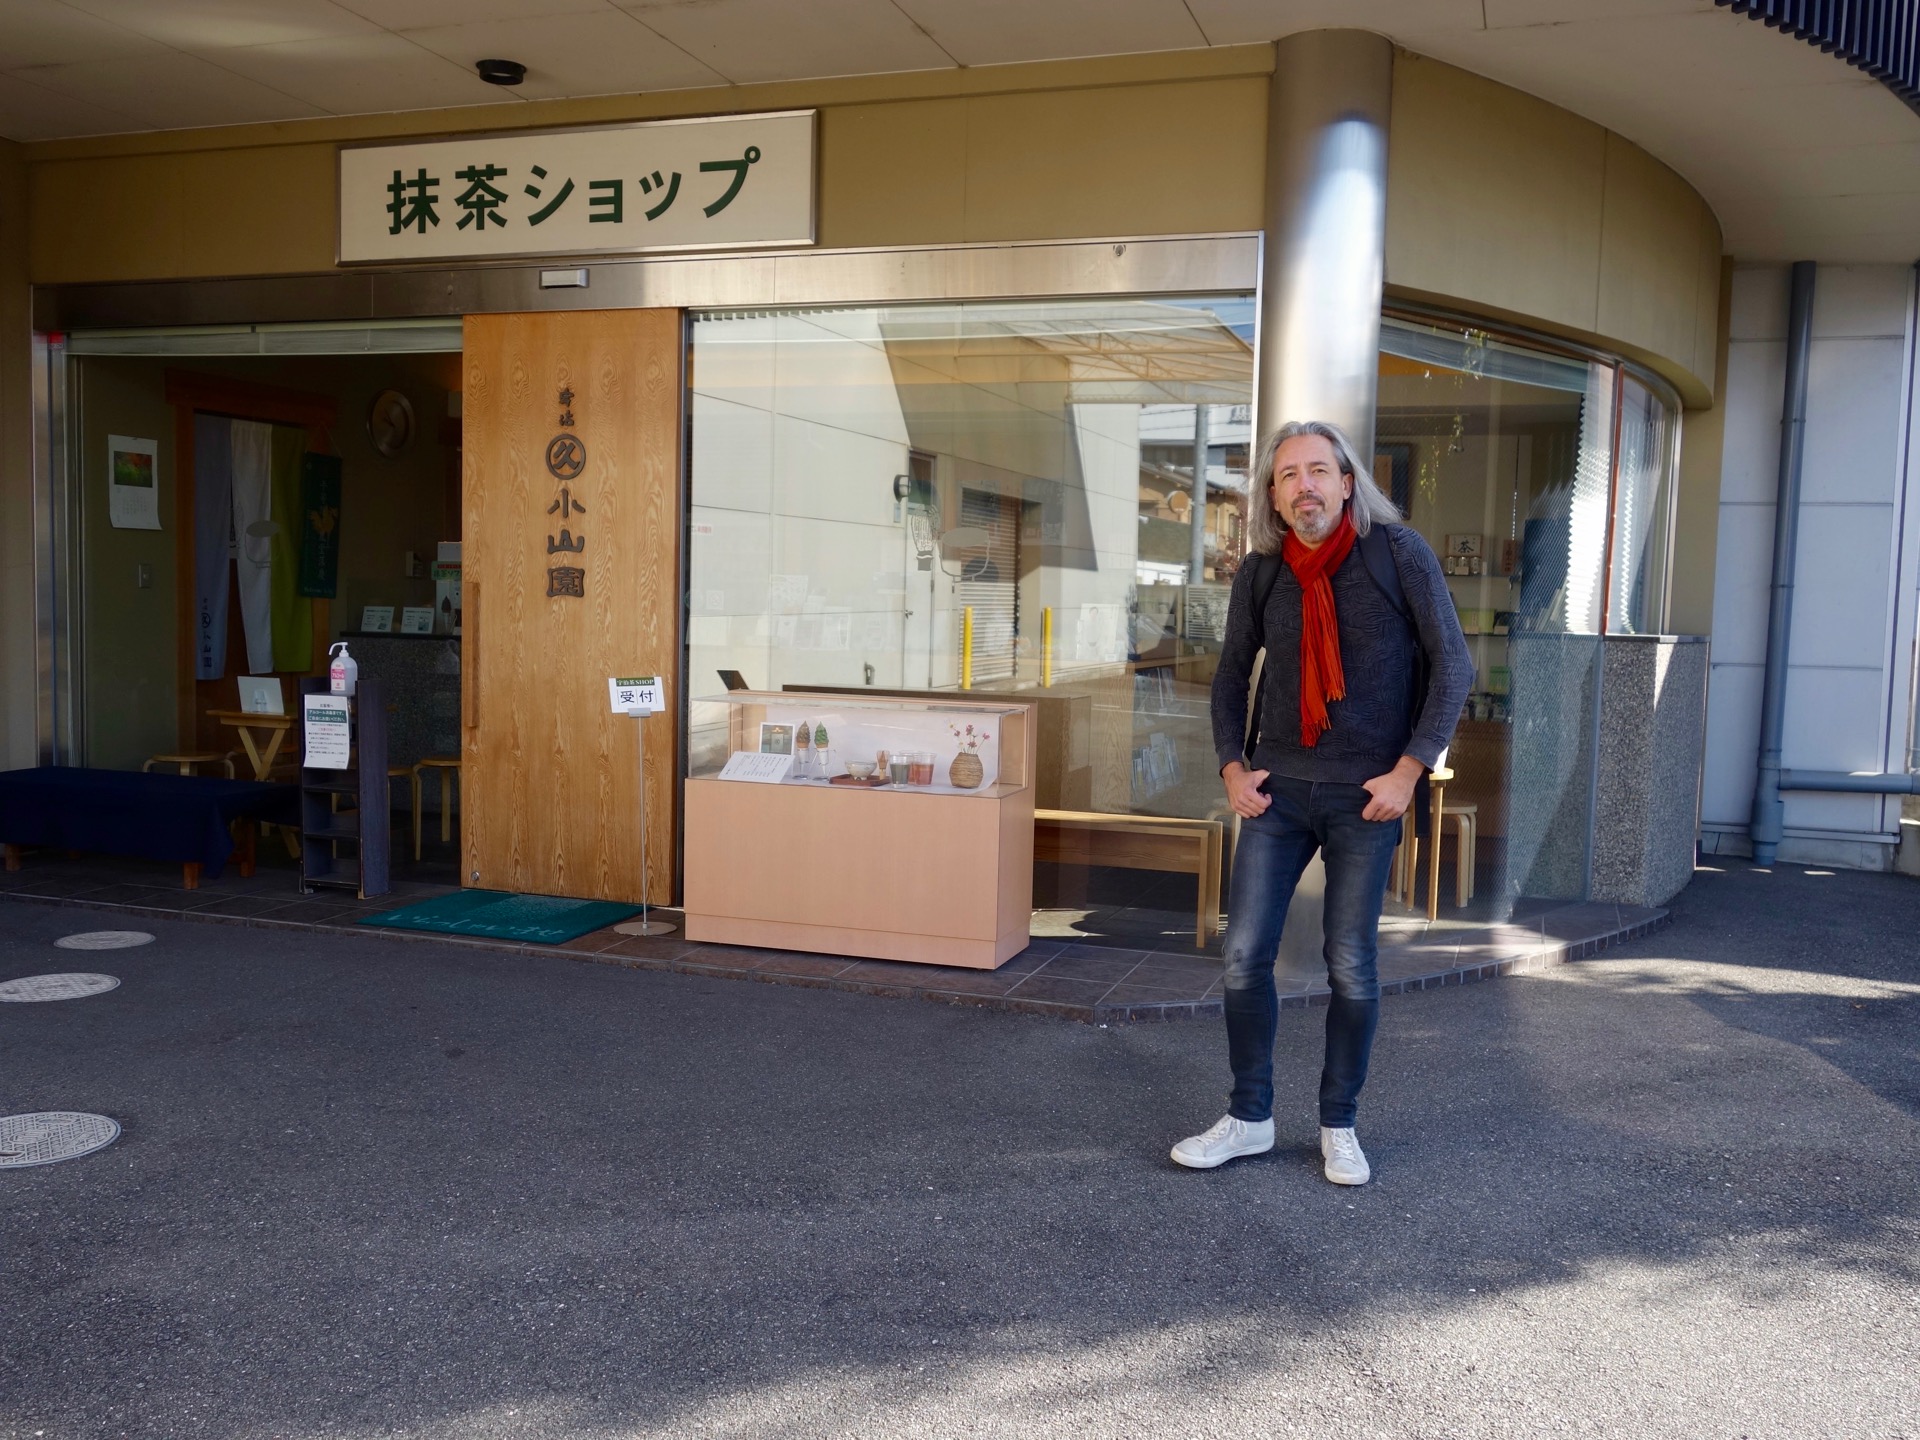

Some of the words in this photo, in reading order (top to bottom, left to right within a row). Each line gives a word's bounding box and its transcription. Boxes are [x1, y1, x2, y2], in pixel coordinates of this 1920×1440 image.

[387, 146, 761, 235] 抹茶ショップ
[620, 689, 654, 704] 受付
